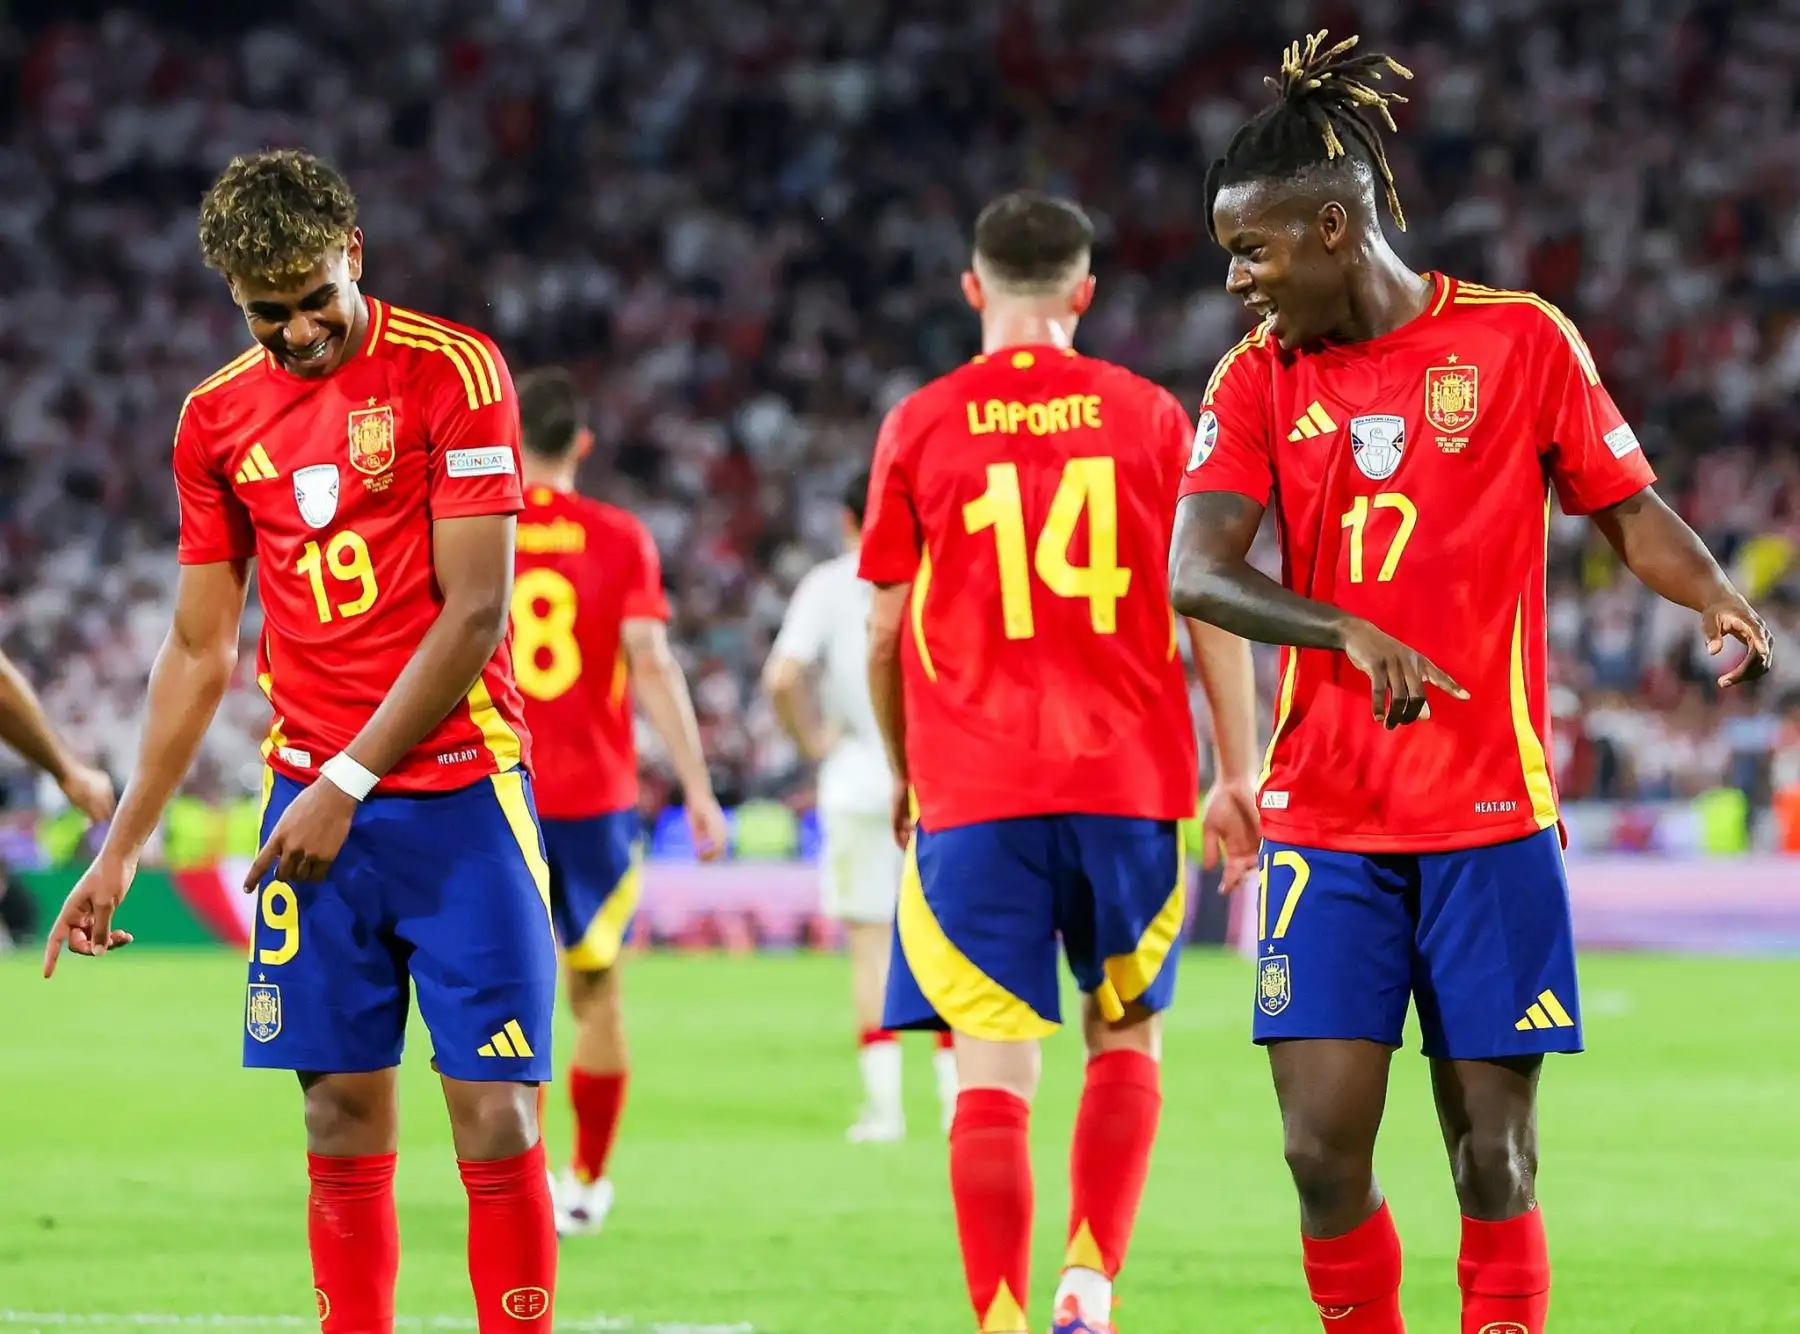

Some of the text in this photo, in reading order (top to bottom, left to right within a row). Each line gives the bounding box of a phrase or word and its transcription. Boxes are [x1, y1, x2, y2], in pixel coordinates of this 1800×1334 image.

[966, 394, 1103, 435] LAPORTE
[296, 530, 379, 624] 19
[962, 456, 1133, 640] 14
[1341, 492, 1418, 584] 17
[510, 568, 583, 701] 8
[1474, 800, 1517, 813] HEAT.RDY
